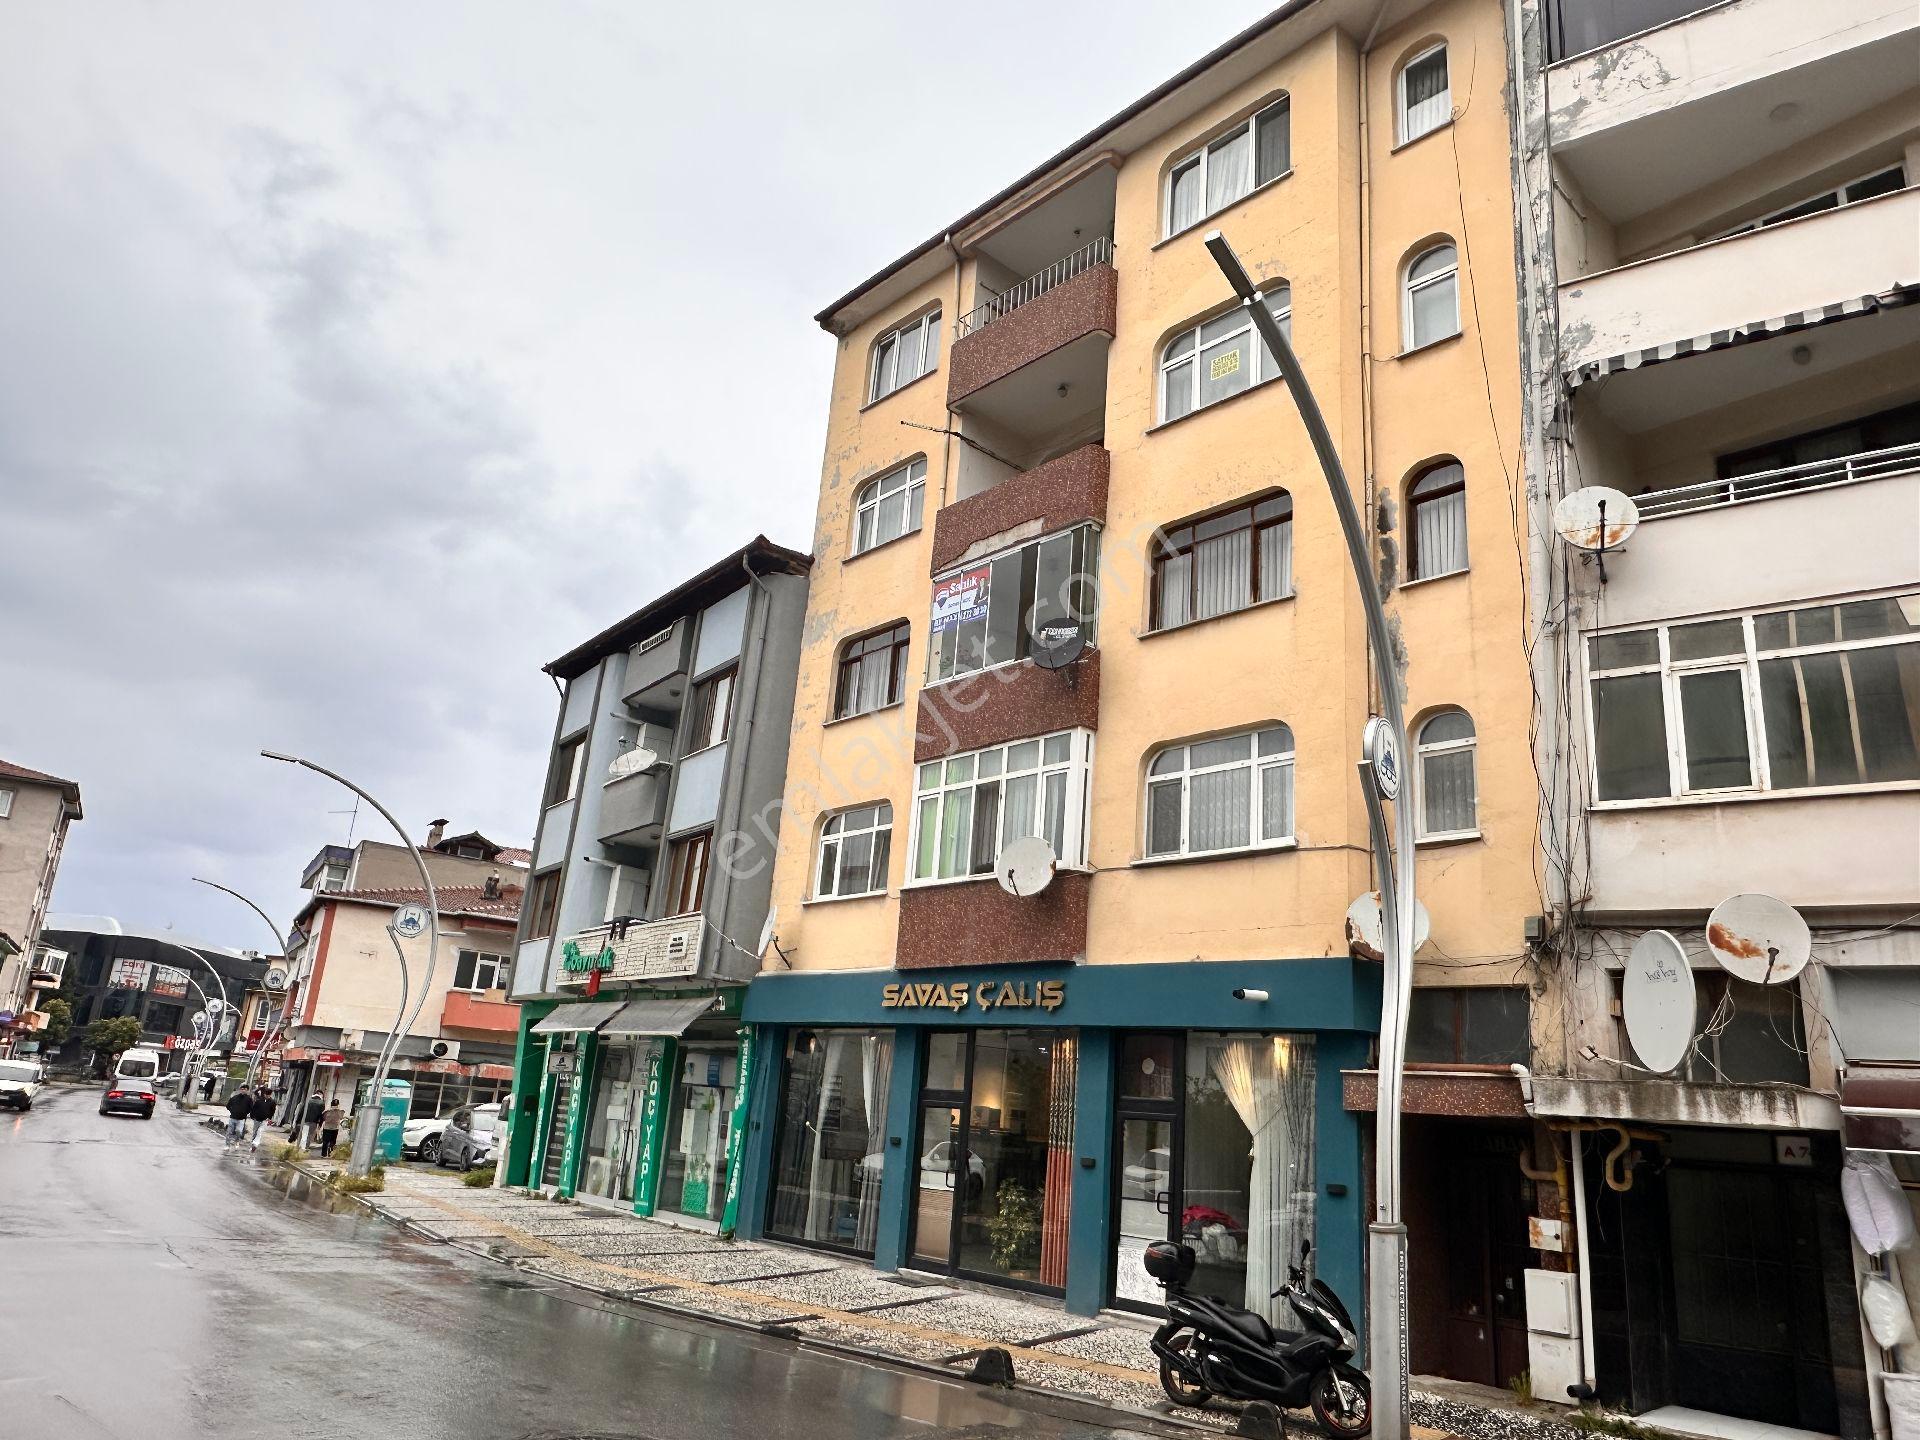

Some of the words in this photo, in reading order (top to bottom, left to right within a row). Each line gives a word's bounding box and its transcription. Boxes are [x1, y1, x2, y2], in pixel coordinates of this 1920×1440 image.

[882, 983, 969, 1012] SAVAŞ
[975, 981, 1065, 1012] ÇALIŞ
[648, 1060, 659, 1120] KOÇ
[640, 1124, 653, 1199] YAPI
